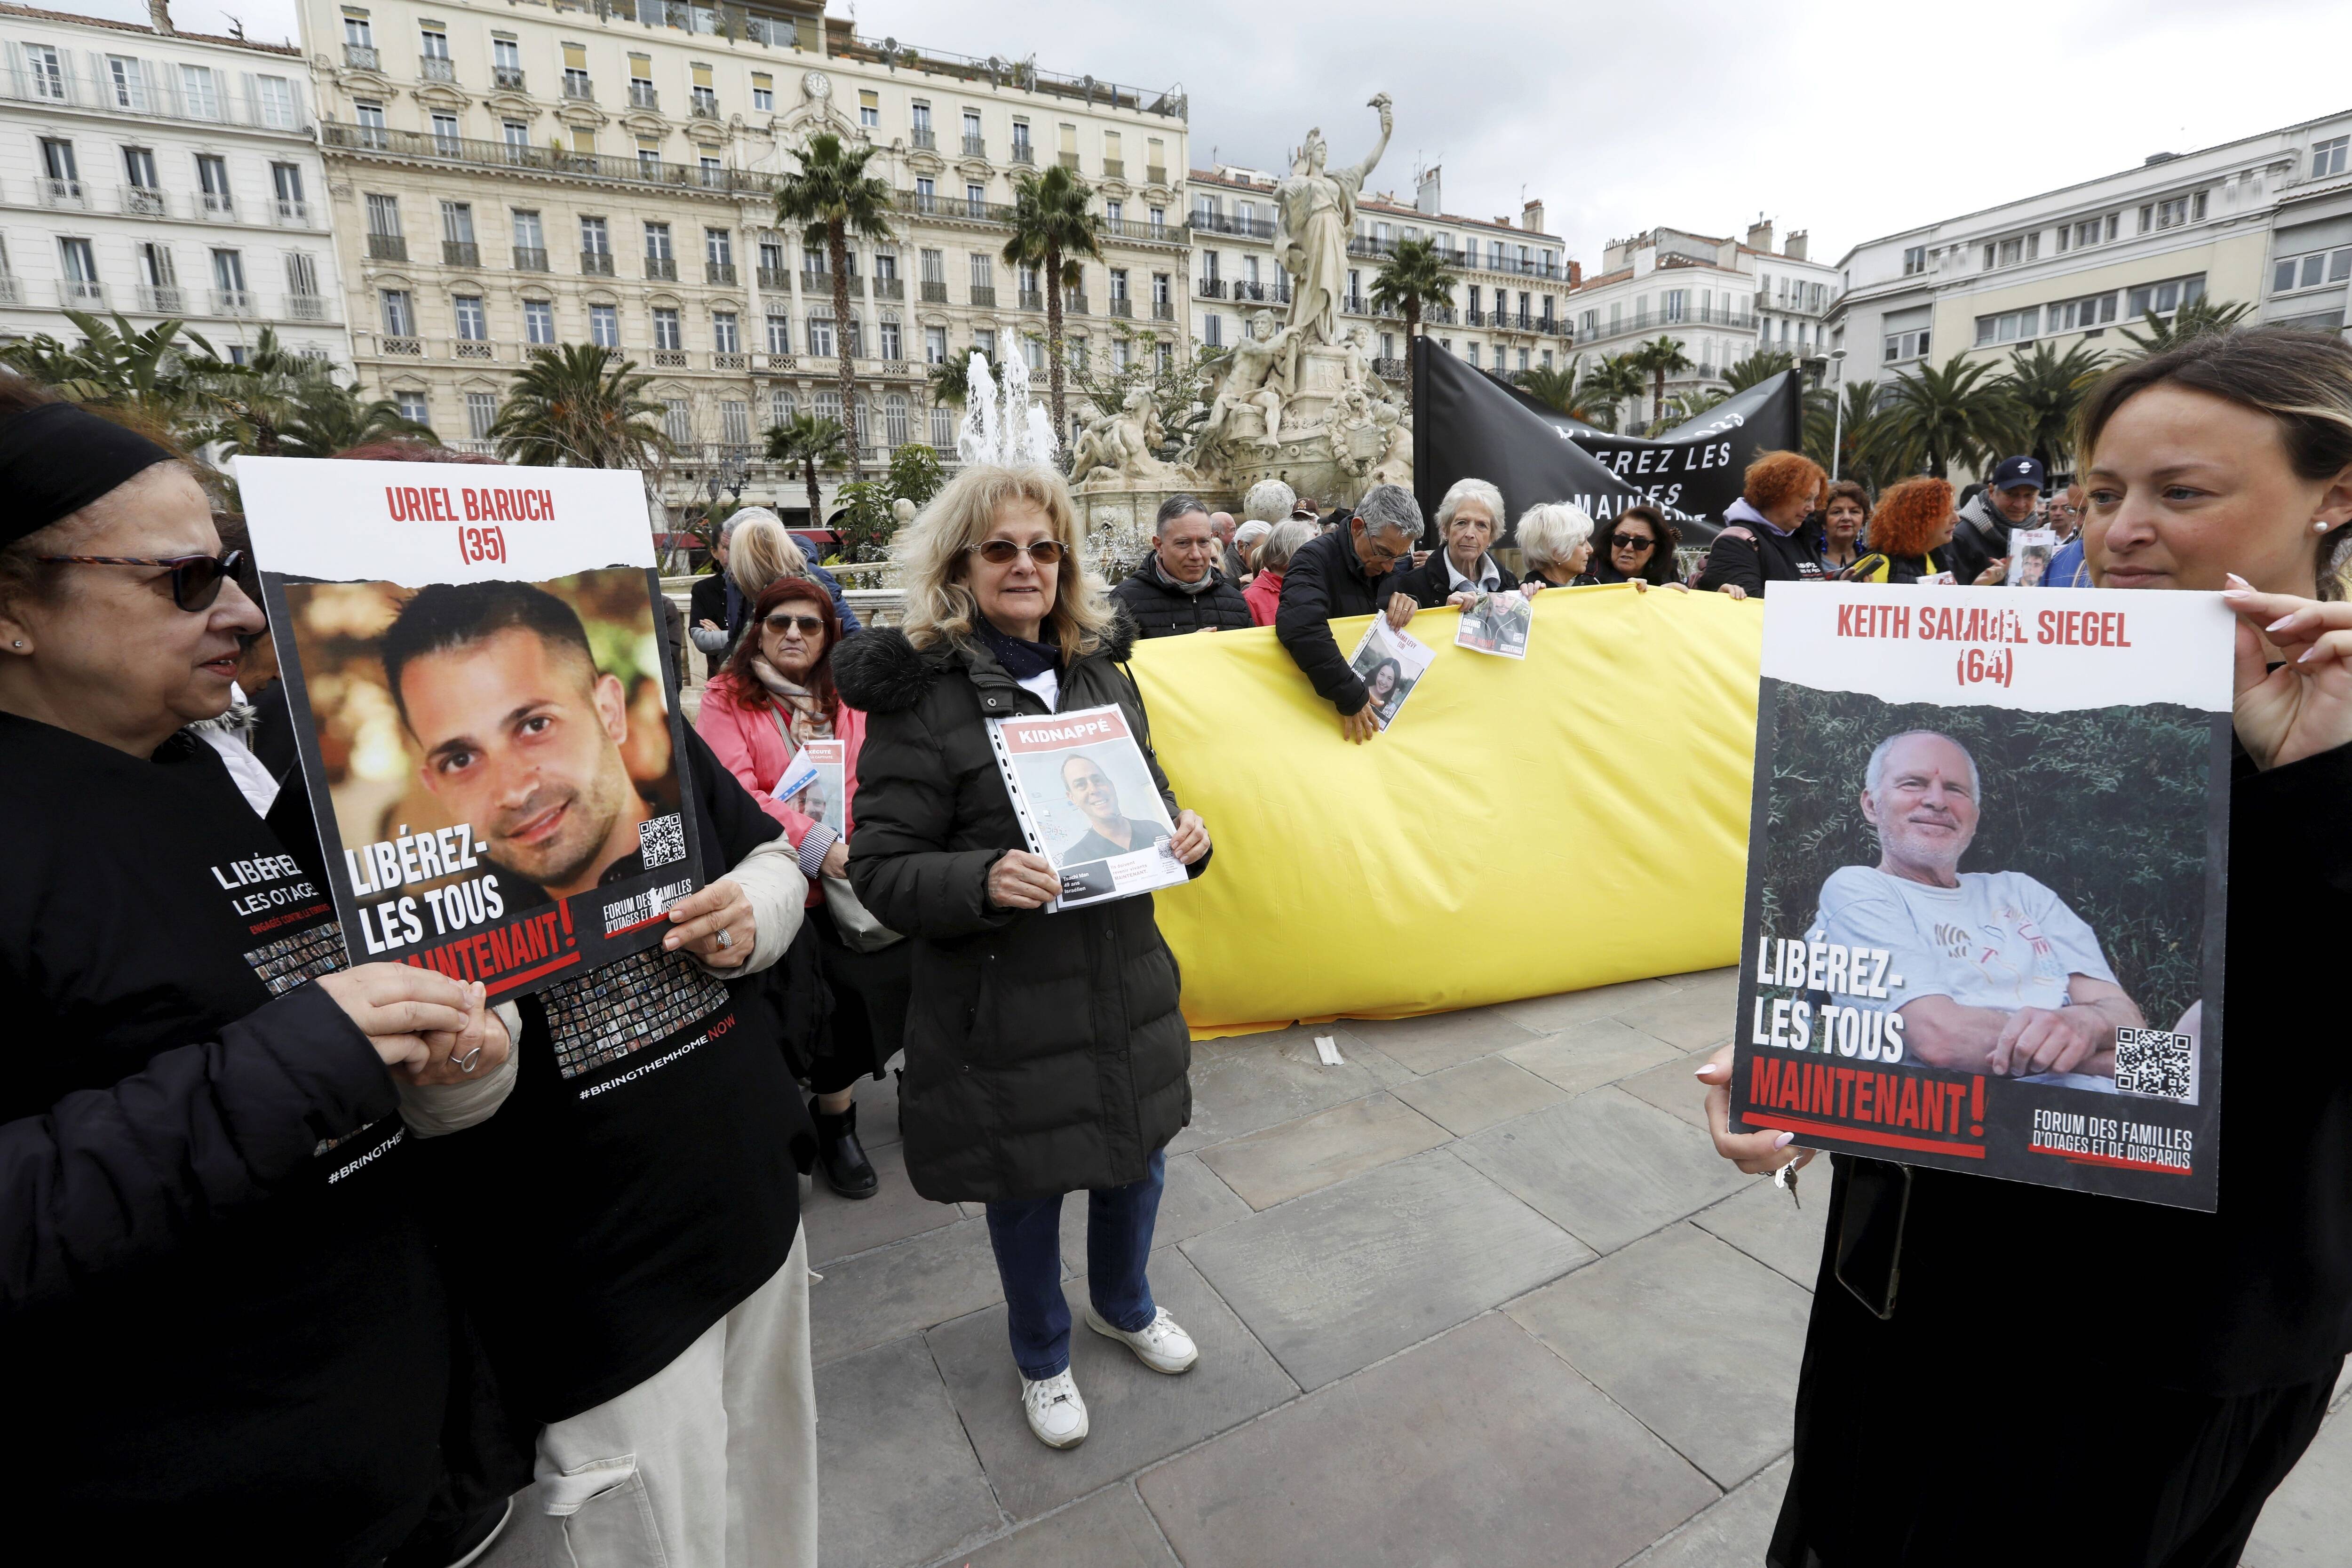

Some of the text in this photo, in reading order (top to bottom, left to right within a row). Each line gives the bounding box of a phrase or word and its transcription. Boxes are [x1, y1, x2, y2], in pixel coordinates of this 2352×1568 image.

[1685, 442, 1731, 470] LES
[386, 486, 555, 522] URIEL BARUCH
[459, 526, 507, 565] (35)
[1460, 634, 1476, 644] HOME
[1477, 637, 1495, 648] NOW!
[1461, 625, 1473, 634] HIM
[1462, 618, 1481, 629] BRING
[1837, 604, 2131, 647] KEITH SAMUEL SIEGEL
[1406, 639, 1417, 649] LEVY
[1957, 648, 2013, 688] (64)
[1018, 718, 1111, 744] KIDNAPPÉ
[344, 823, 487, 896] LIBÉREZ-
[232, 882, 320, 916] LES OTAGE
[358, 875, 504, 955] LES TOUS
[603, 878, 692, 921] FORUM DES AMILLES
[605, 911, 639, 934] D'OTAGES
[640, 908, 649, 922] ET
[1757, 930, 1903, 998] LIBÉREZ-
[1752, 996, 1904, 1063] LES TOUS
[2033, 1130, 2190, 1169] D'OTAGES ET DE DISPARUS
[2034, 1109, 2193, 1151] FORUM DES FAMILLES
